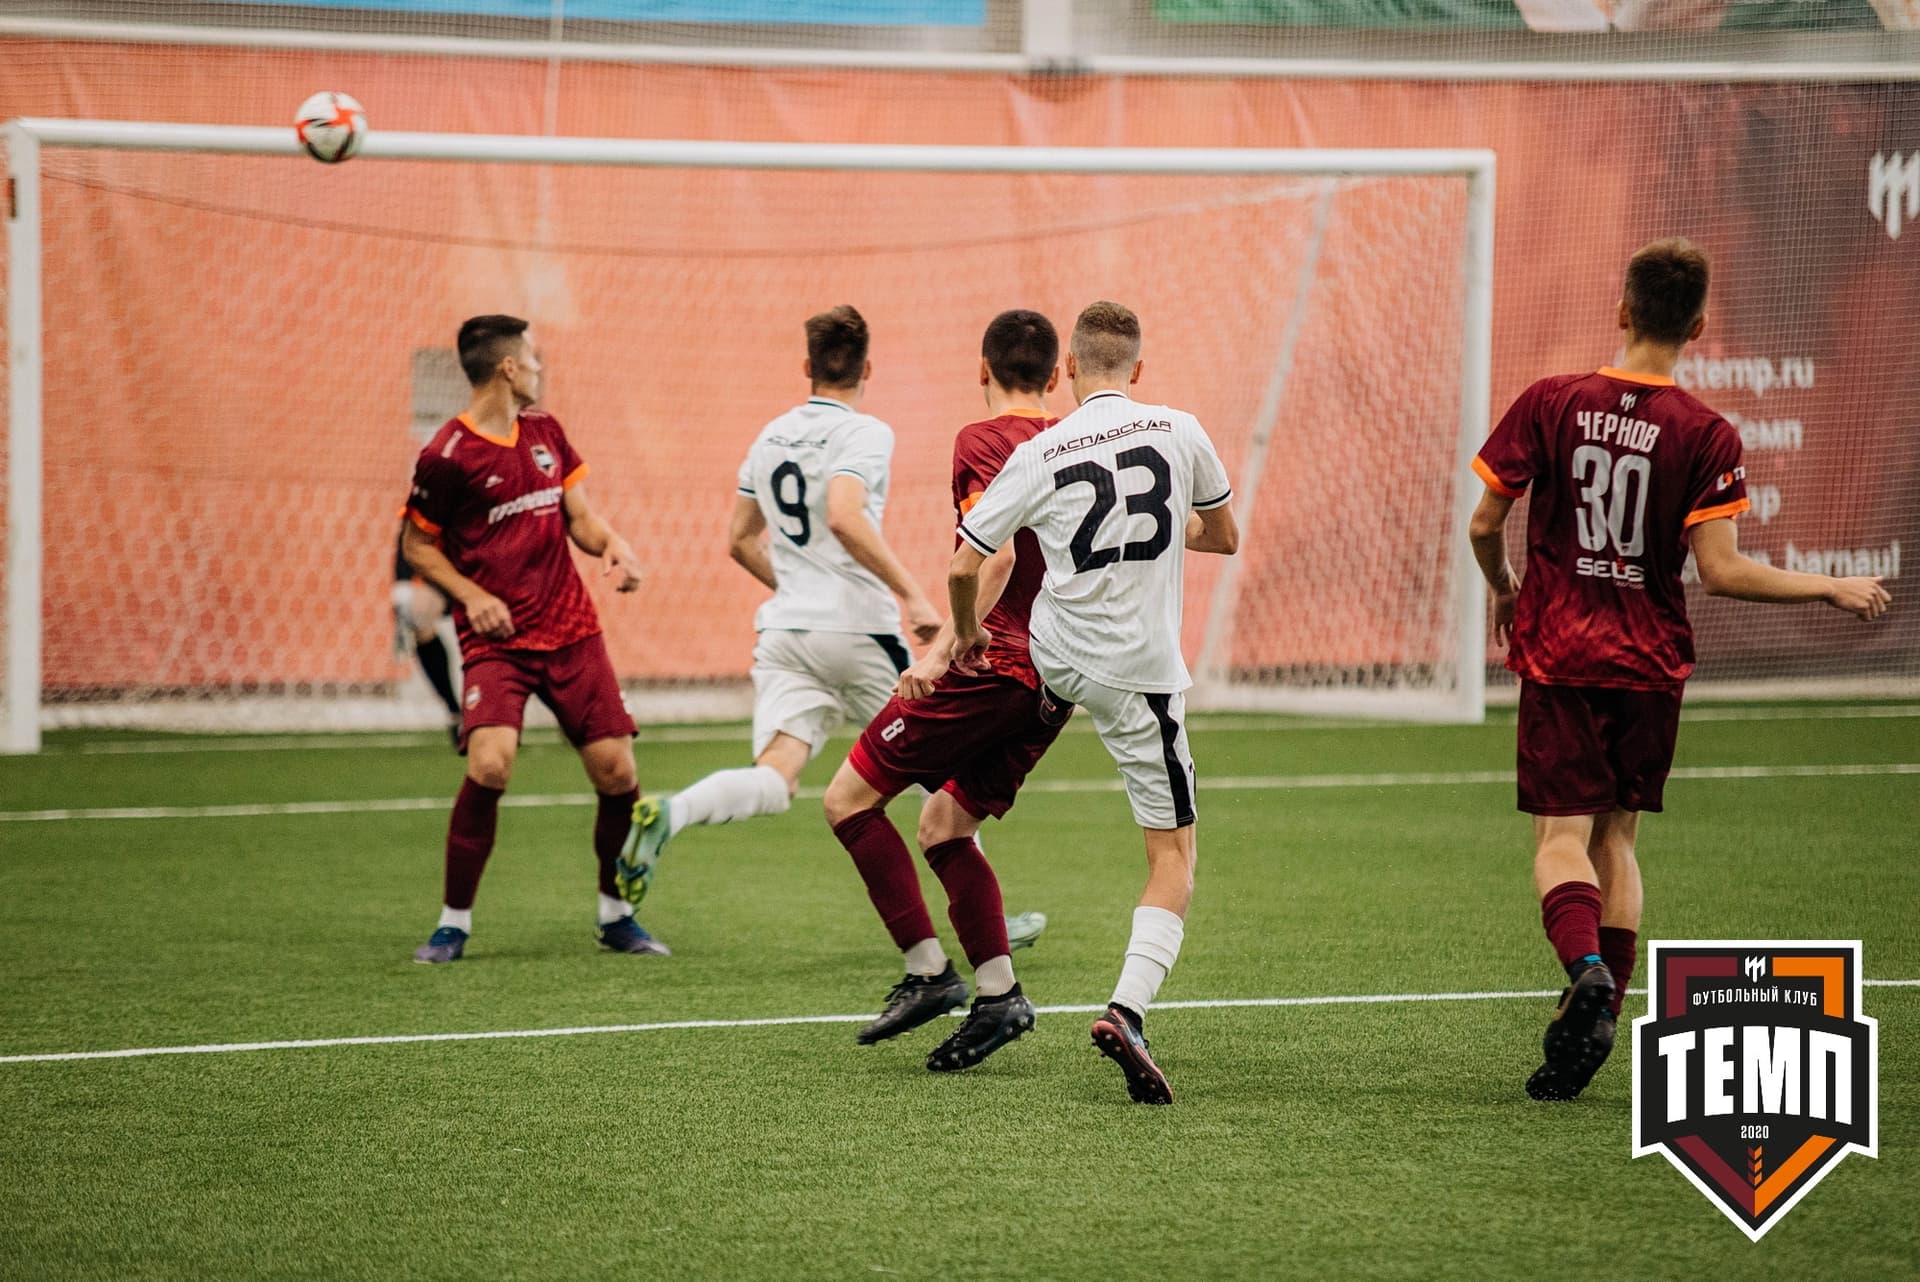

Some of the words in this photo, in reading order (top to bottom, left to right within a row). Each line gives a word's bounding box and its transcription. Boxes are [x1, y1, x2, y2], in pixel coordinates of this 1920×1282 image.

[1576, 410, 1661, 453] ЧЕРНОВ
[770, 459, 812, 547] 9
[1053, 444, 1173, 575] 23
[1572, 444, 1652, 558] 30
[1575, 556, 1646, 583] SELS
[880, 717, 906, 742] 8
